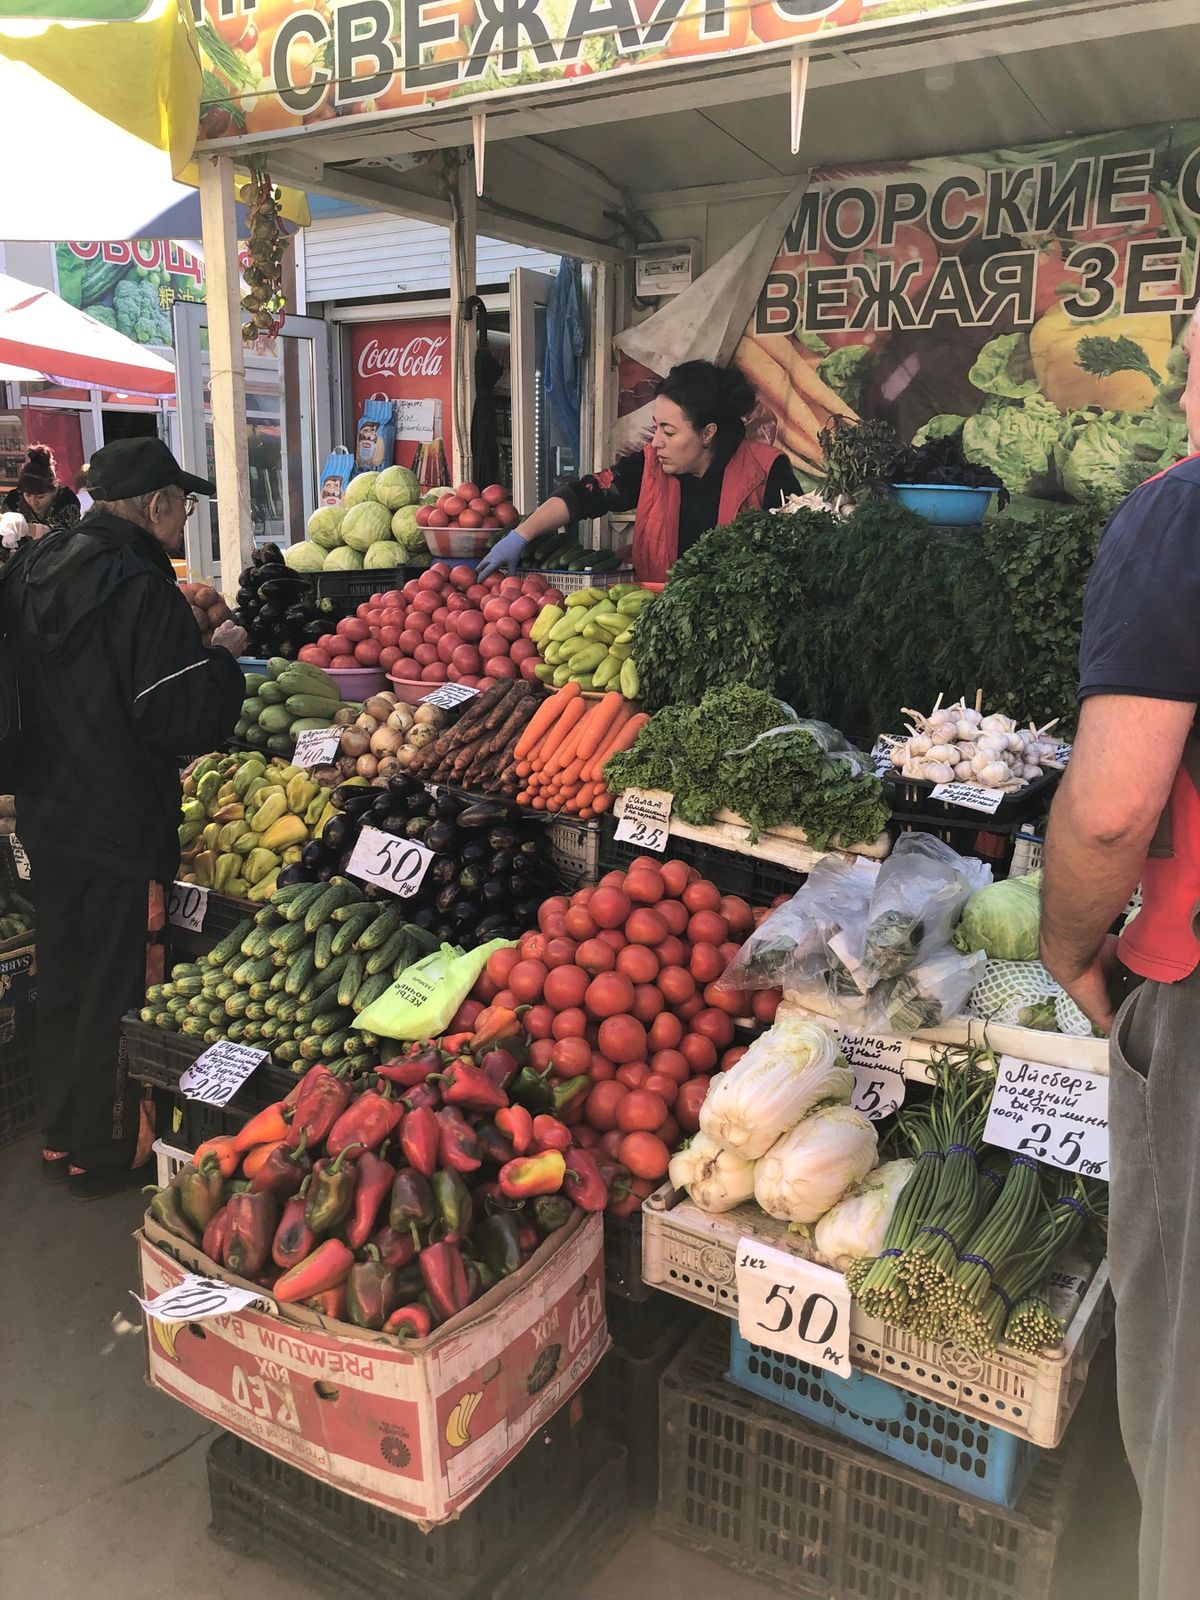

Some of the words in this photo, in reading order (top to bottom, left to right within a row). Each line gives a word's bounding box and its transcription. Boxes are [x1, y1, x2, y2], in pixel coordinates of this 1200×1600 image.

[357, 336, 449, 378] Coca-Cola
[302, 748, 324, 765] 40
[365, 840, 422, 882] 50
[837, 1035, 902, 1053] пинат
[183, 1078, 233, 1100] 200
[853, 1076, 885, 1112] 5
[998, 1084, 1082, 1107] полезный
[1005, 1064, 1097, 1094] Айсберг
[1017, 1123, 1085, 1166] 25
[740, 1255, 767, 1269] 1кг
[756, 1284, 838, 1344] 50
[254, 1355, 291, 1384] BOX
[258, 1326, 375, 1381] PREMIUM
[231, 1364, 301, 1433] RED
